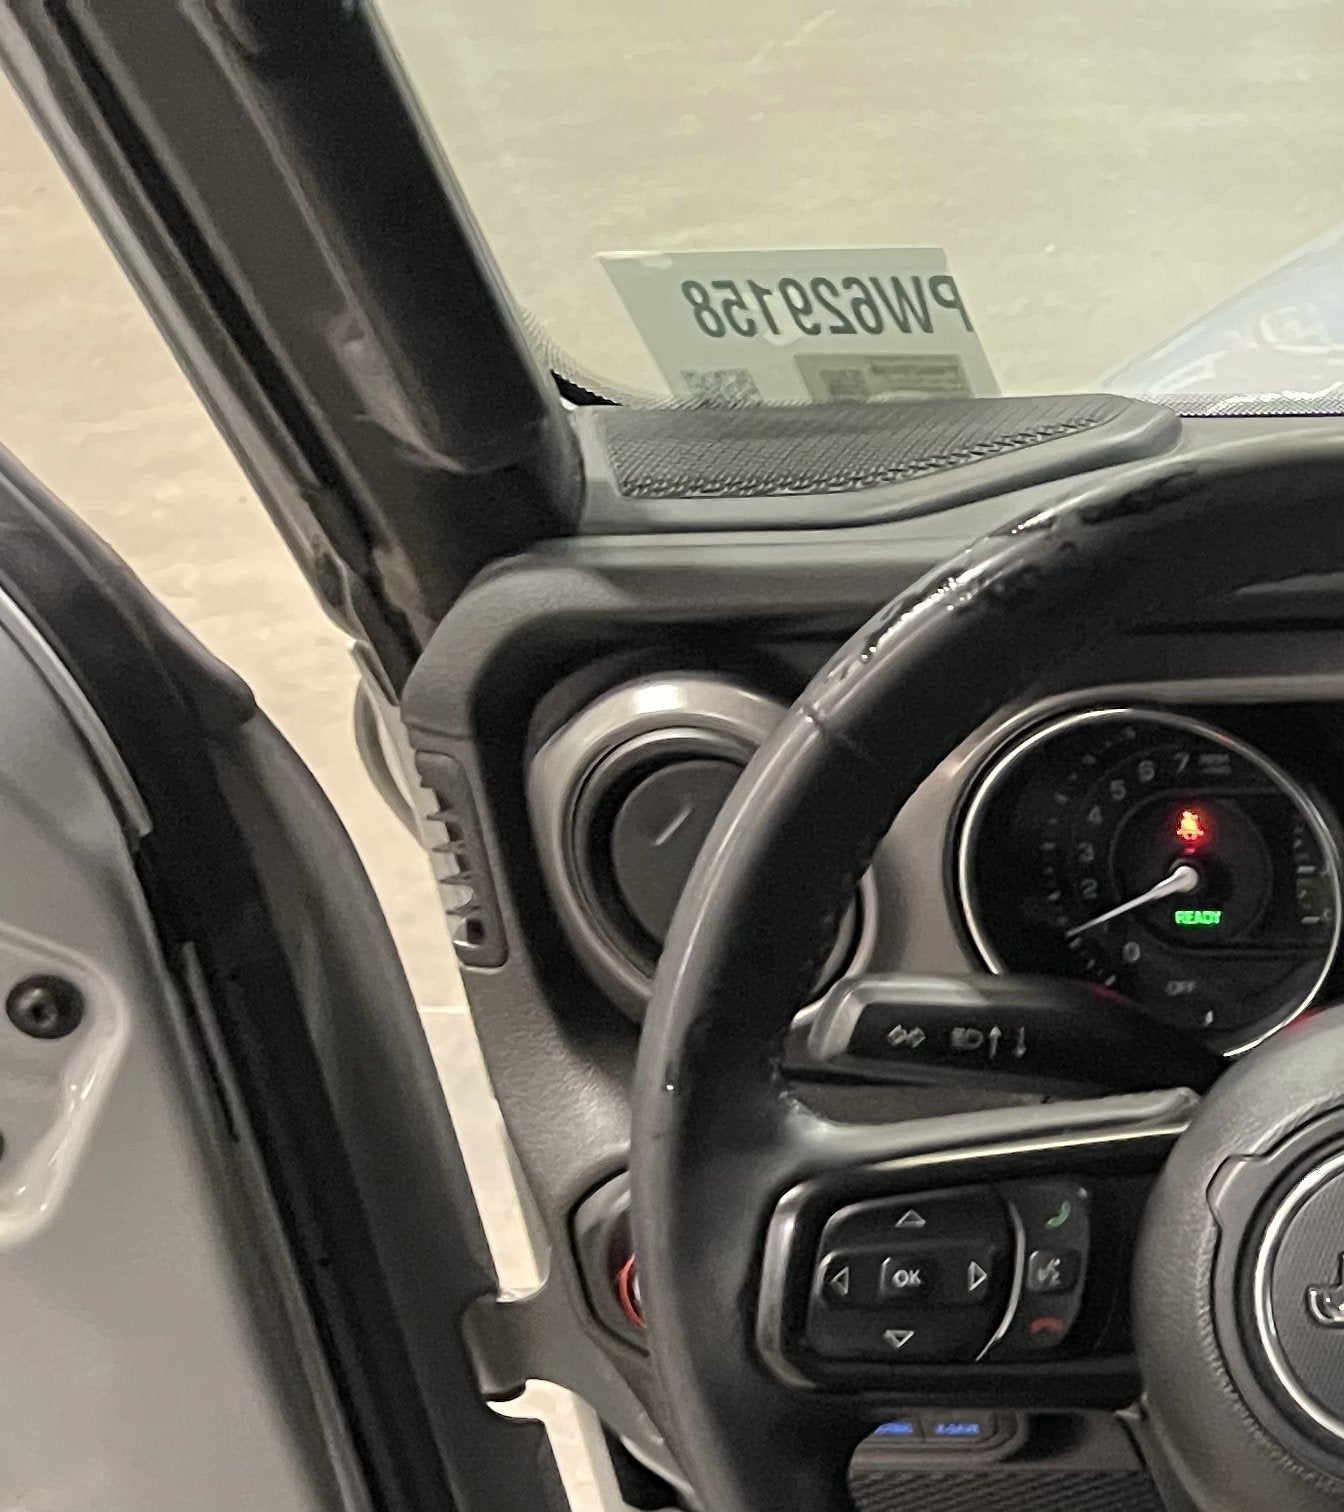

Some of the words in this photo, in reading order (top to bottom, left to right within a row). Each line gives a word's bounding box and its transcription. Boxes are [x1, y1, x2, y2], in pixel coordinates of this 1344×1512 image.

[1137, 759, 1156, 782] 6
[1109, 779, 1127, 800] 5
[1077, 842, 1096, 863] 3
[1174, 909, 1223, 926] READY
[891, 1267, 923, 1288] OK
